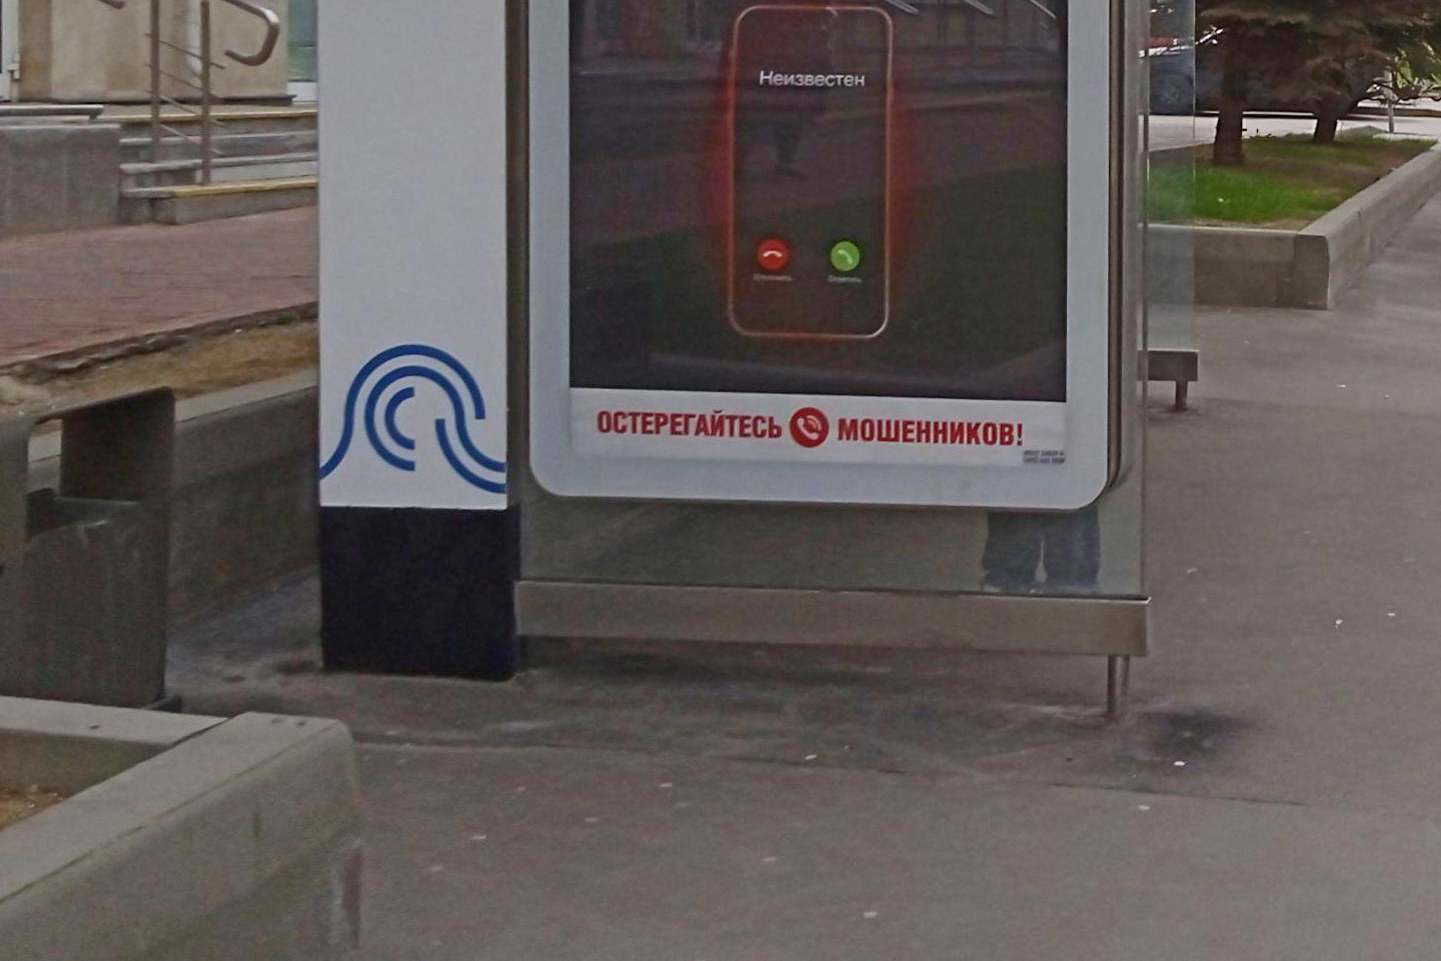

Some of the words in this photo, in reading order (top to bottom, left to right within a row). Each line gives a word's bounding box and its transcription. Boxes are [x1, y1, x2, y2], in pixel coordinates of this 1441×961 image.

[759, 70, 865, 87] Неизвестен
[598, 410, 782, 439] ОСТЕРЕГАЙТЕСЬ
[837, 419, 1023, 447] МОШЕННИКОВ!
